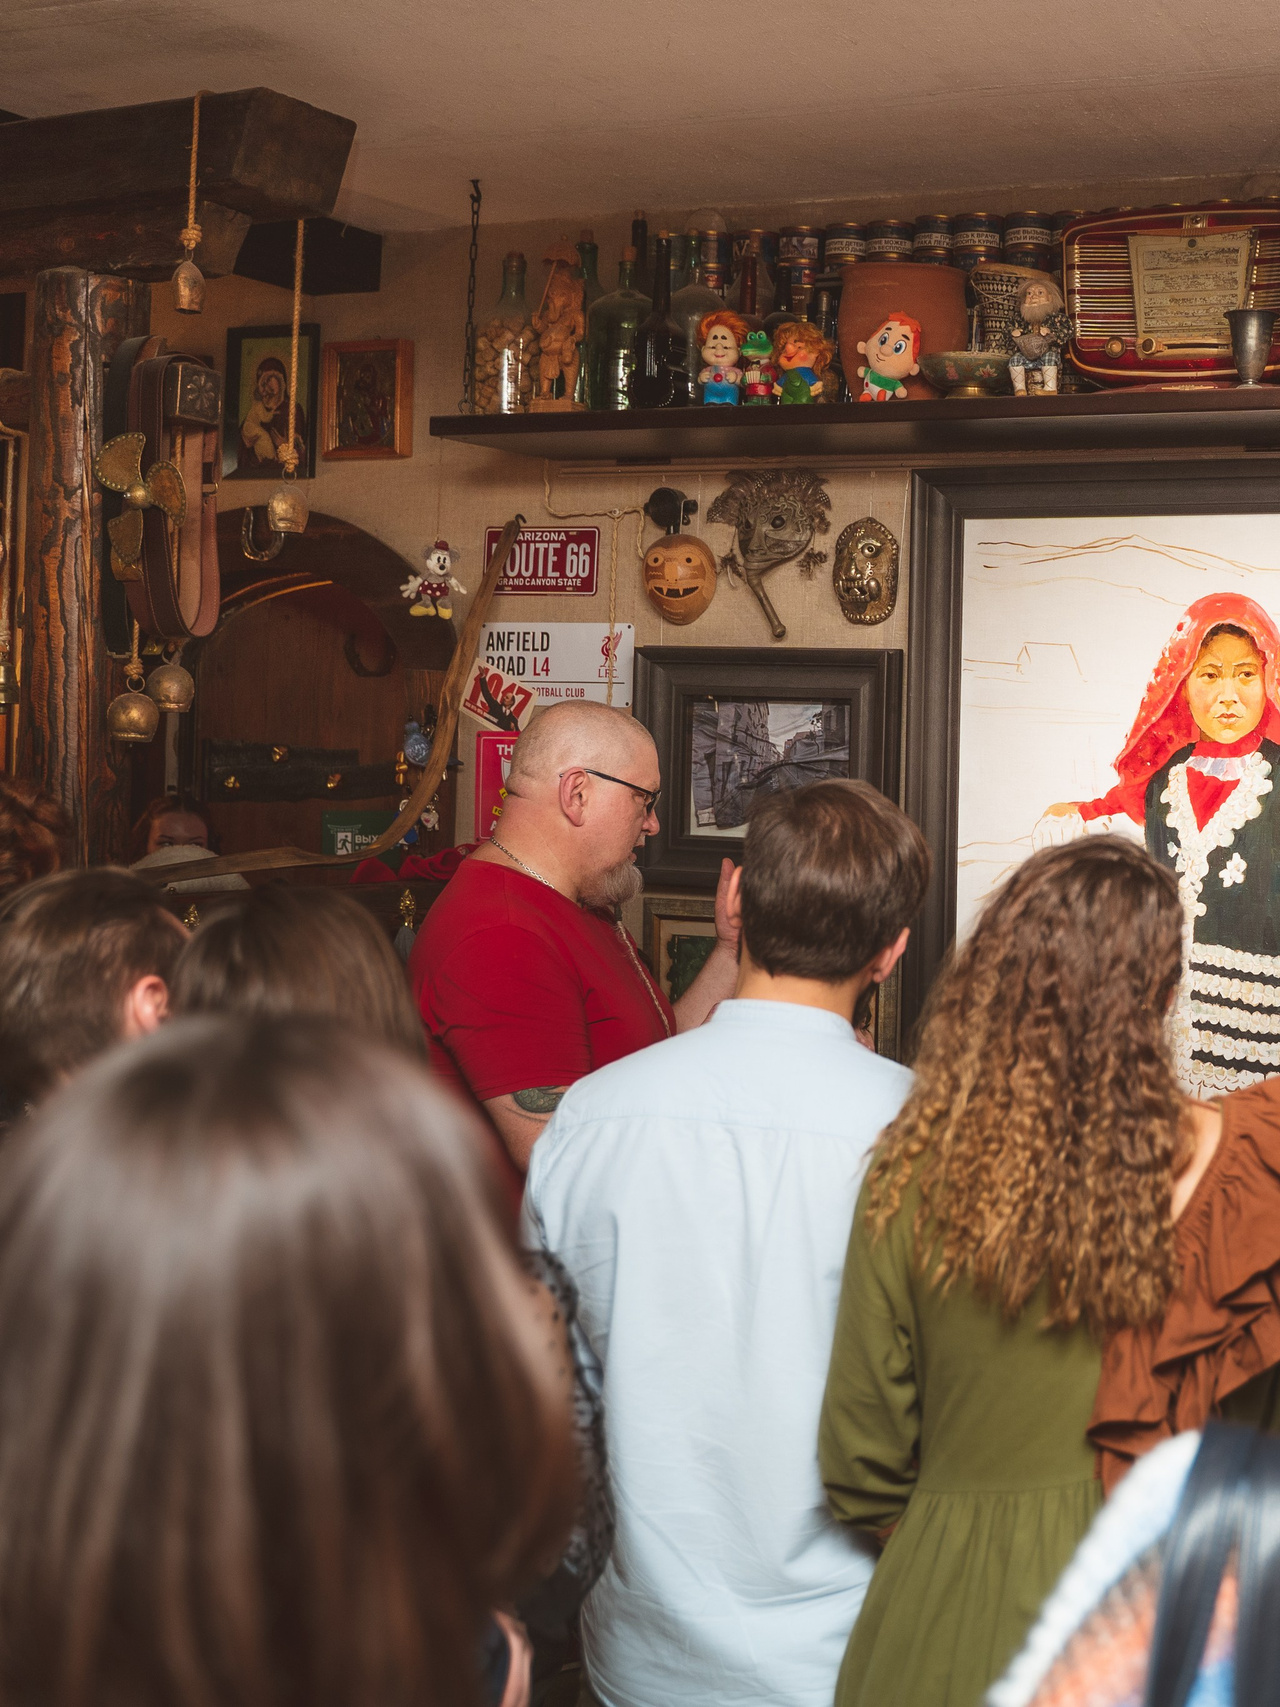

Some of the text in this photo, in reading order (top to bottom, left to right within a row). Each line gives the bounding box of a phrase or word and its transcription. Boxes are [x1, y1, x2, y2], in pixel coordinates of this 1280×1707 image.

[878, 245, 913, 253] БЕСПЛОДИ
[516, 532, 567, 541] ARIZONA
[492, 542, 591, 578] OUTE 66
[498, 577, 582, 586] GRAND CANYON STATE
[486, 631, 550, 652] ANFIELD
[533, 656, 551, 676] L4
[531, 687, 585, 698] OTBALL CLUB
[496, 744, 513, 756] TH
[355, 834, 380, 844] ВЫХ
